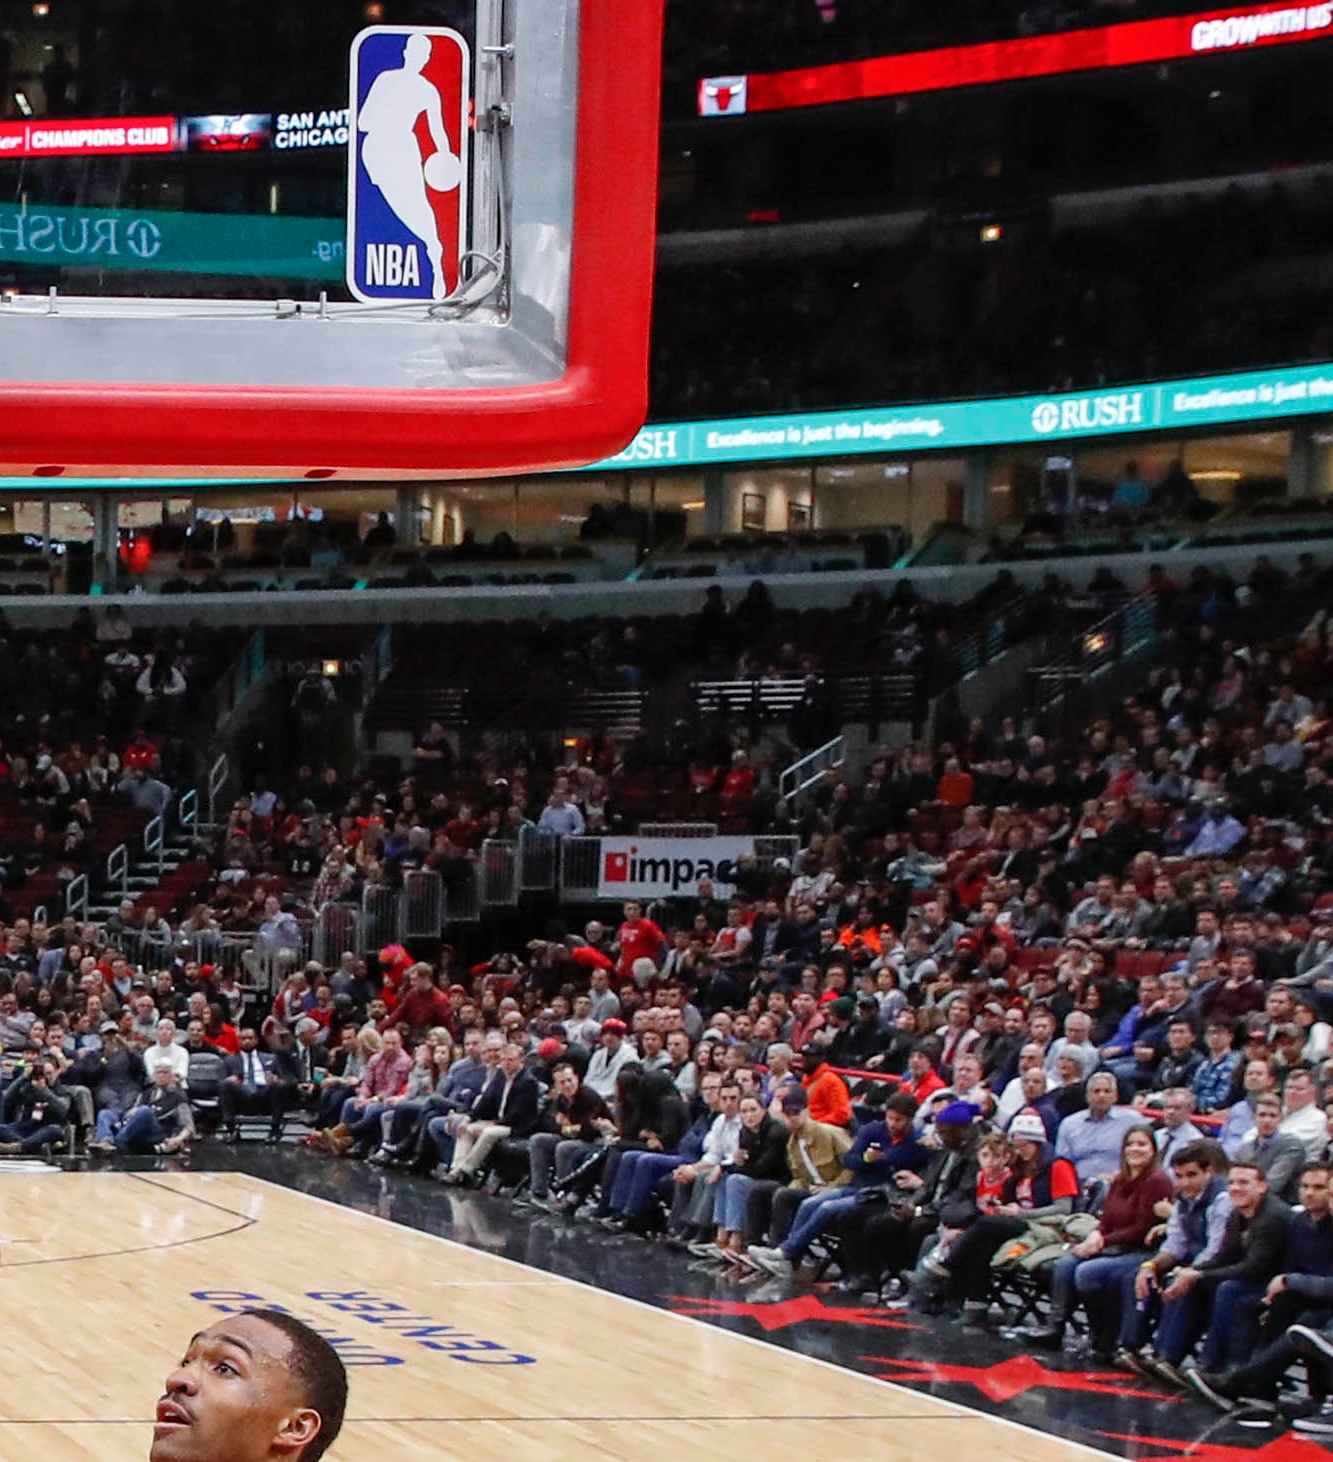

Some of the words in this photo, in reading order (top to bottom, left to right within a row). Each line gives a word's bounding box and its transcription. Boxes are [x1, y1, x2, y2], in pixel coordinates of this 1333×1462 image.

[32, 130, 123, 150] CHAMPIONS
[126, 127, 169, 147] CLUB
[275, 128, 349, 148] CHICAG
[277, 114, 303, 131] SAN
[307, 112, 350, 129] ANT
[365, 244, 420, 287] NBA
[1061, 392, 1144, 431] RUSH
[612, 431, 678, 461] USH
[630, 846, 738, 891] impac
[305, 1291, 537, 1365] CENTER
